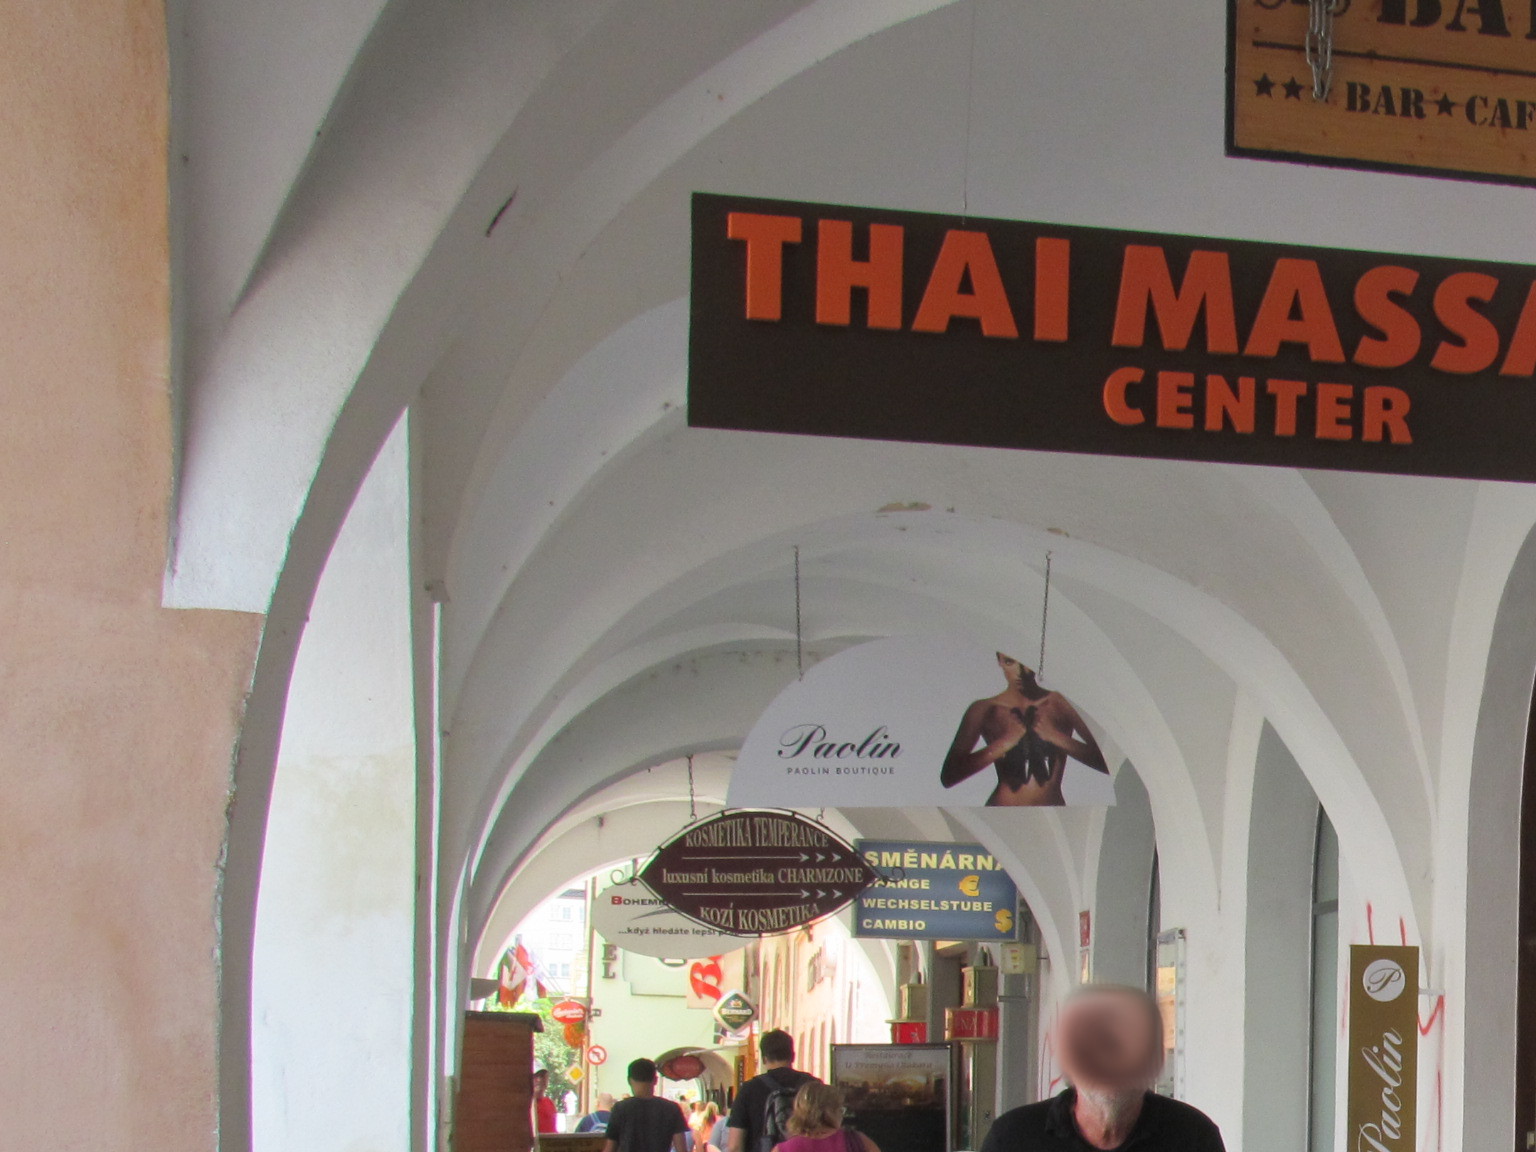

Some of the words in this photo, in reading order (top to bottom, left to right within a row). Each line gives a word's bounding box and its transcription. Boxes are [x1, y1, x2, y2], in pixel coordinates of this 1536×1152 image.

[1345, 81, 1427, 119] BAR
[726, 211, 1073, 345] THAI
[1103, 366, 1413, 443] CENTER
[777, 723, 904, 760] Paolin
[787, 767, 830, 775] PAOLIN
[836, 767, 895, 776] BOUTIQUE
[685, 817, 751, 848] KOSMETIKA
[754, 817, 829, 848] TEMPERANCE
[864, 849, 1005, 871] SMĚNÁRN
[662, 868, 708, 884] luxusní
[712, 868, 775, 884] kosmetika
[778, 867, 864, 884] CHARMZONE
[866, 878, 930, 890] HANGE
[700, 901, 734, 929] KOZÍ
[738, 903, 821, 932] KOSMETIKA
[862, 898, 993, 912] WECHSELSTUBE
[862, 919, 926, 930] CAMBIO
